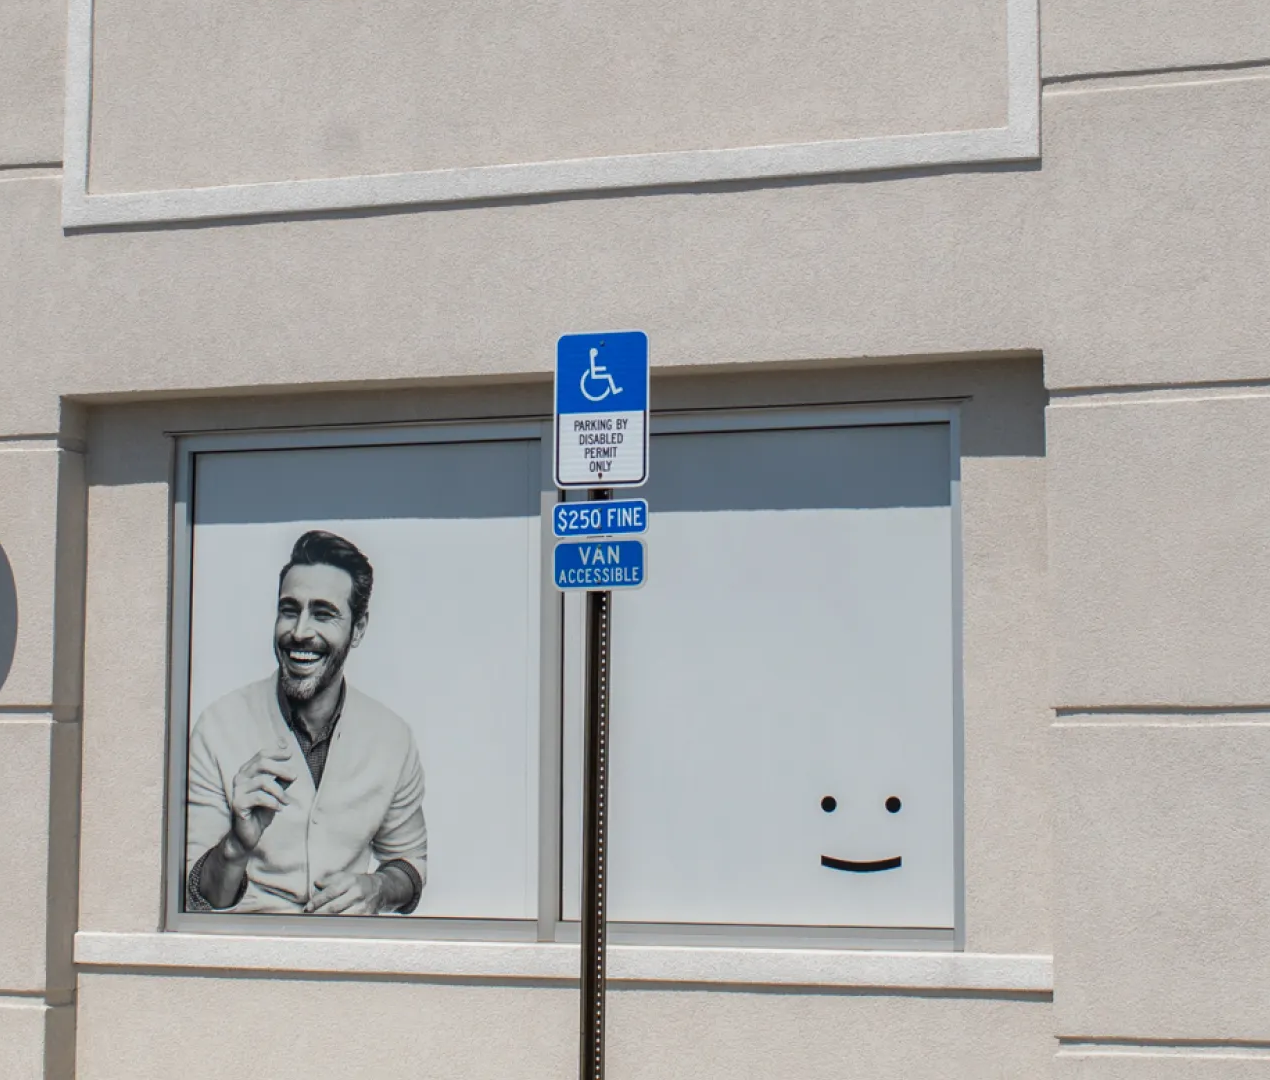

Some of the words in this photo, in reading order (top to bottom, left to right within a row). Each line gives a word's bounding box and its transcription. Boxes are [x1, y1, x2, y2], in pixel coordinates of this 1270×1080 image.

[574, 419, 612, 432] PARKING
[616, 418, 628, 430] BY
[579, 432, 623, 445] DISABLED
[584, 446, 618, 459] PERMIT
[589, 460, 612, 473] ONLY
[558, 508, 602, 531] $250
[607, 507, 642, 527] FINE
[578, 545, 620, 565] VAN
[559, 566, 640, 584] ACCESSIBLE
